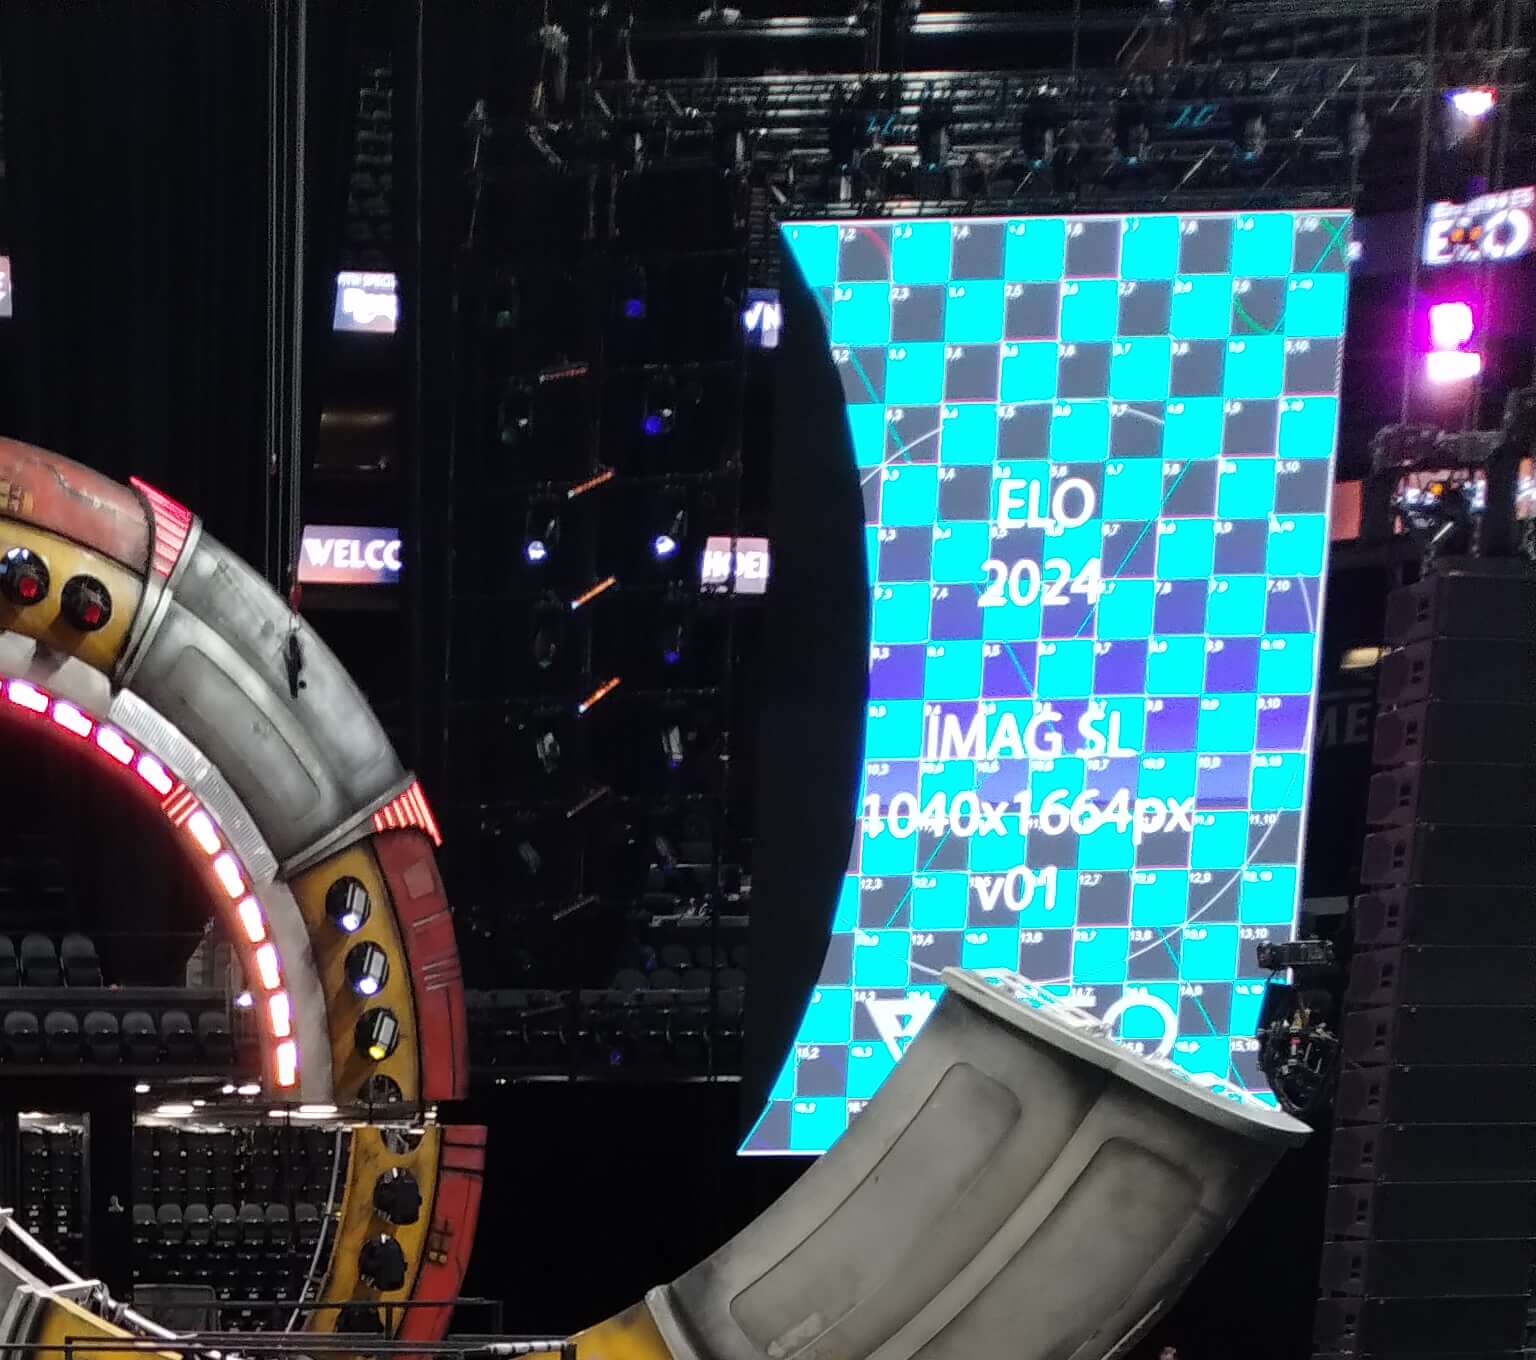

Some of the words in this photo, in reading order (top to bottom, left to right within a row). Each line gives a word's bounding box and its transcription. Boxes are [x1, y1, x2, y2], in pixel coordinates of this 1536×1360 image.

[996, 478, 1096, 530] ELO
[978, 557, 1103, 607] 2024
[926, 710, 1063, 760] IMAG
[1075, 708, 1139, 759] SL
[862, 788, 1196, 846] 1040x1664px
[975, 864, 1058, 912] v01
